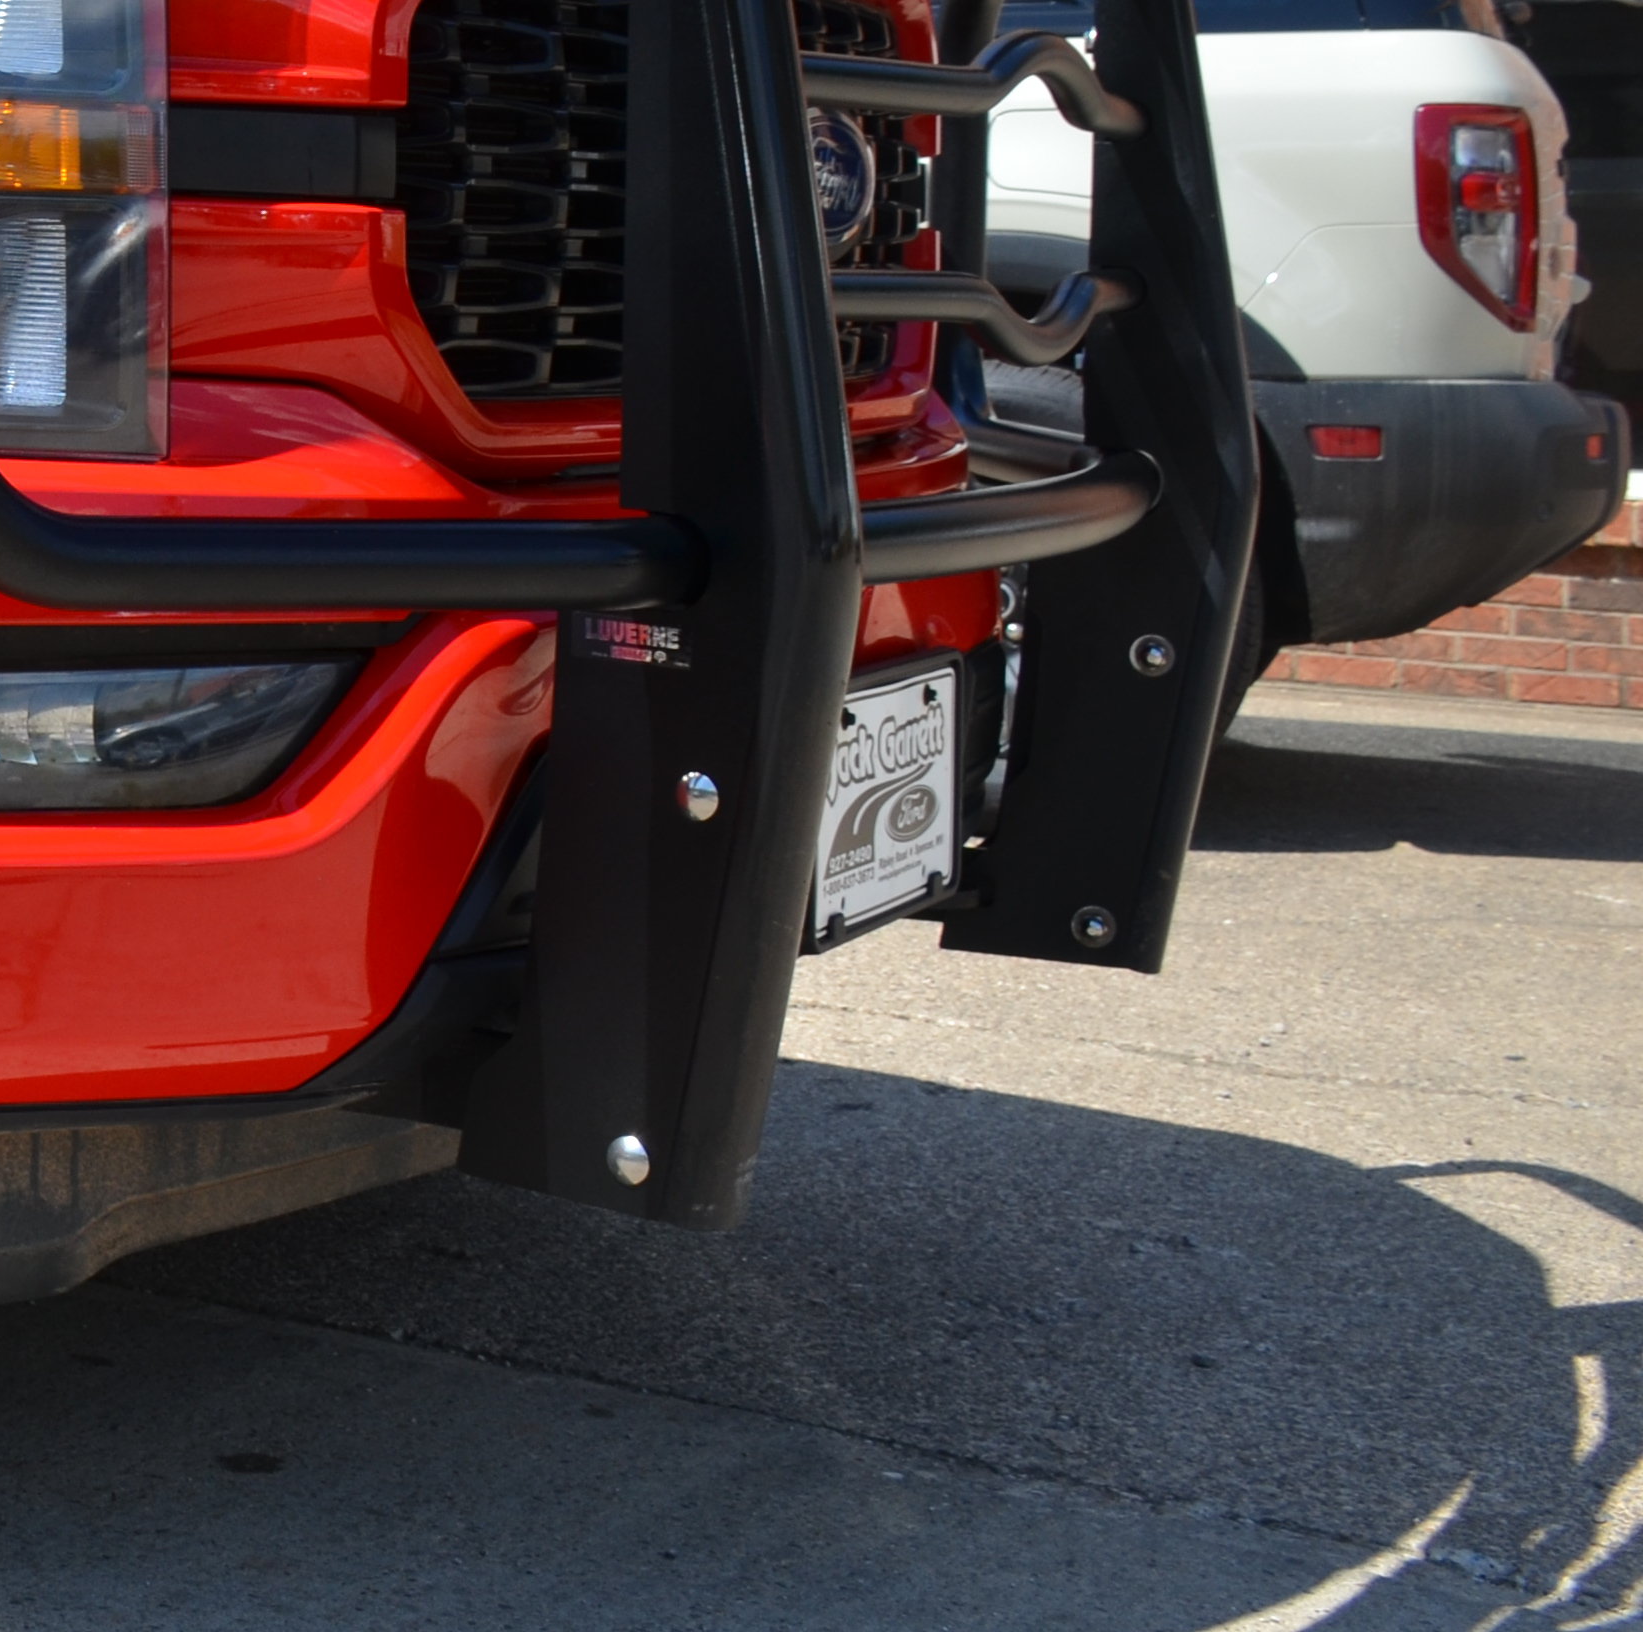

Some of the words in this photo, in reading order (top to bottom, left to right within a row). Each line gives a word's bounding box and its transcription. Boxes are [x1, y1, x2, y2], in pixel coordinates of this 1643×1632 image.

[585, 617, 681, 650] LUVERNE
[826, 724, 876, 808] Jack
[877, 702, 945, 774] Garrett
[897, 791, 928, 829] Ford
